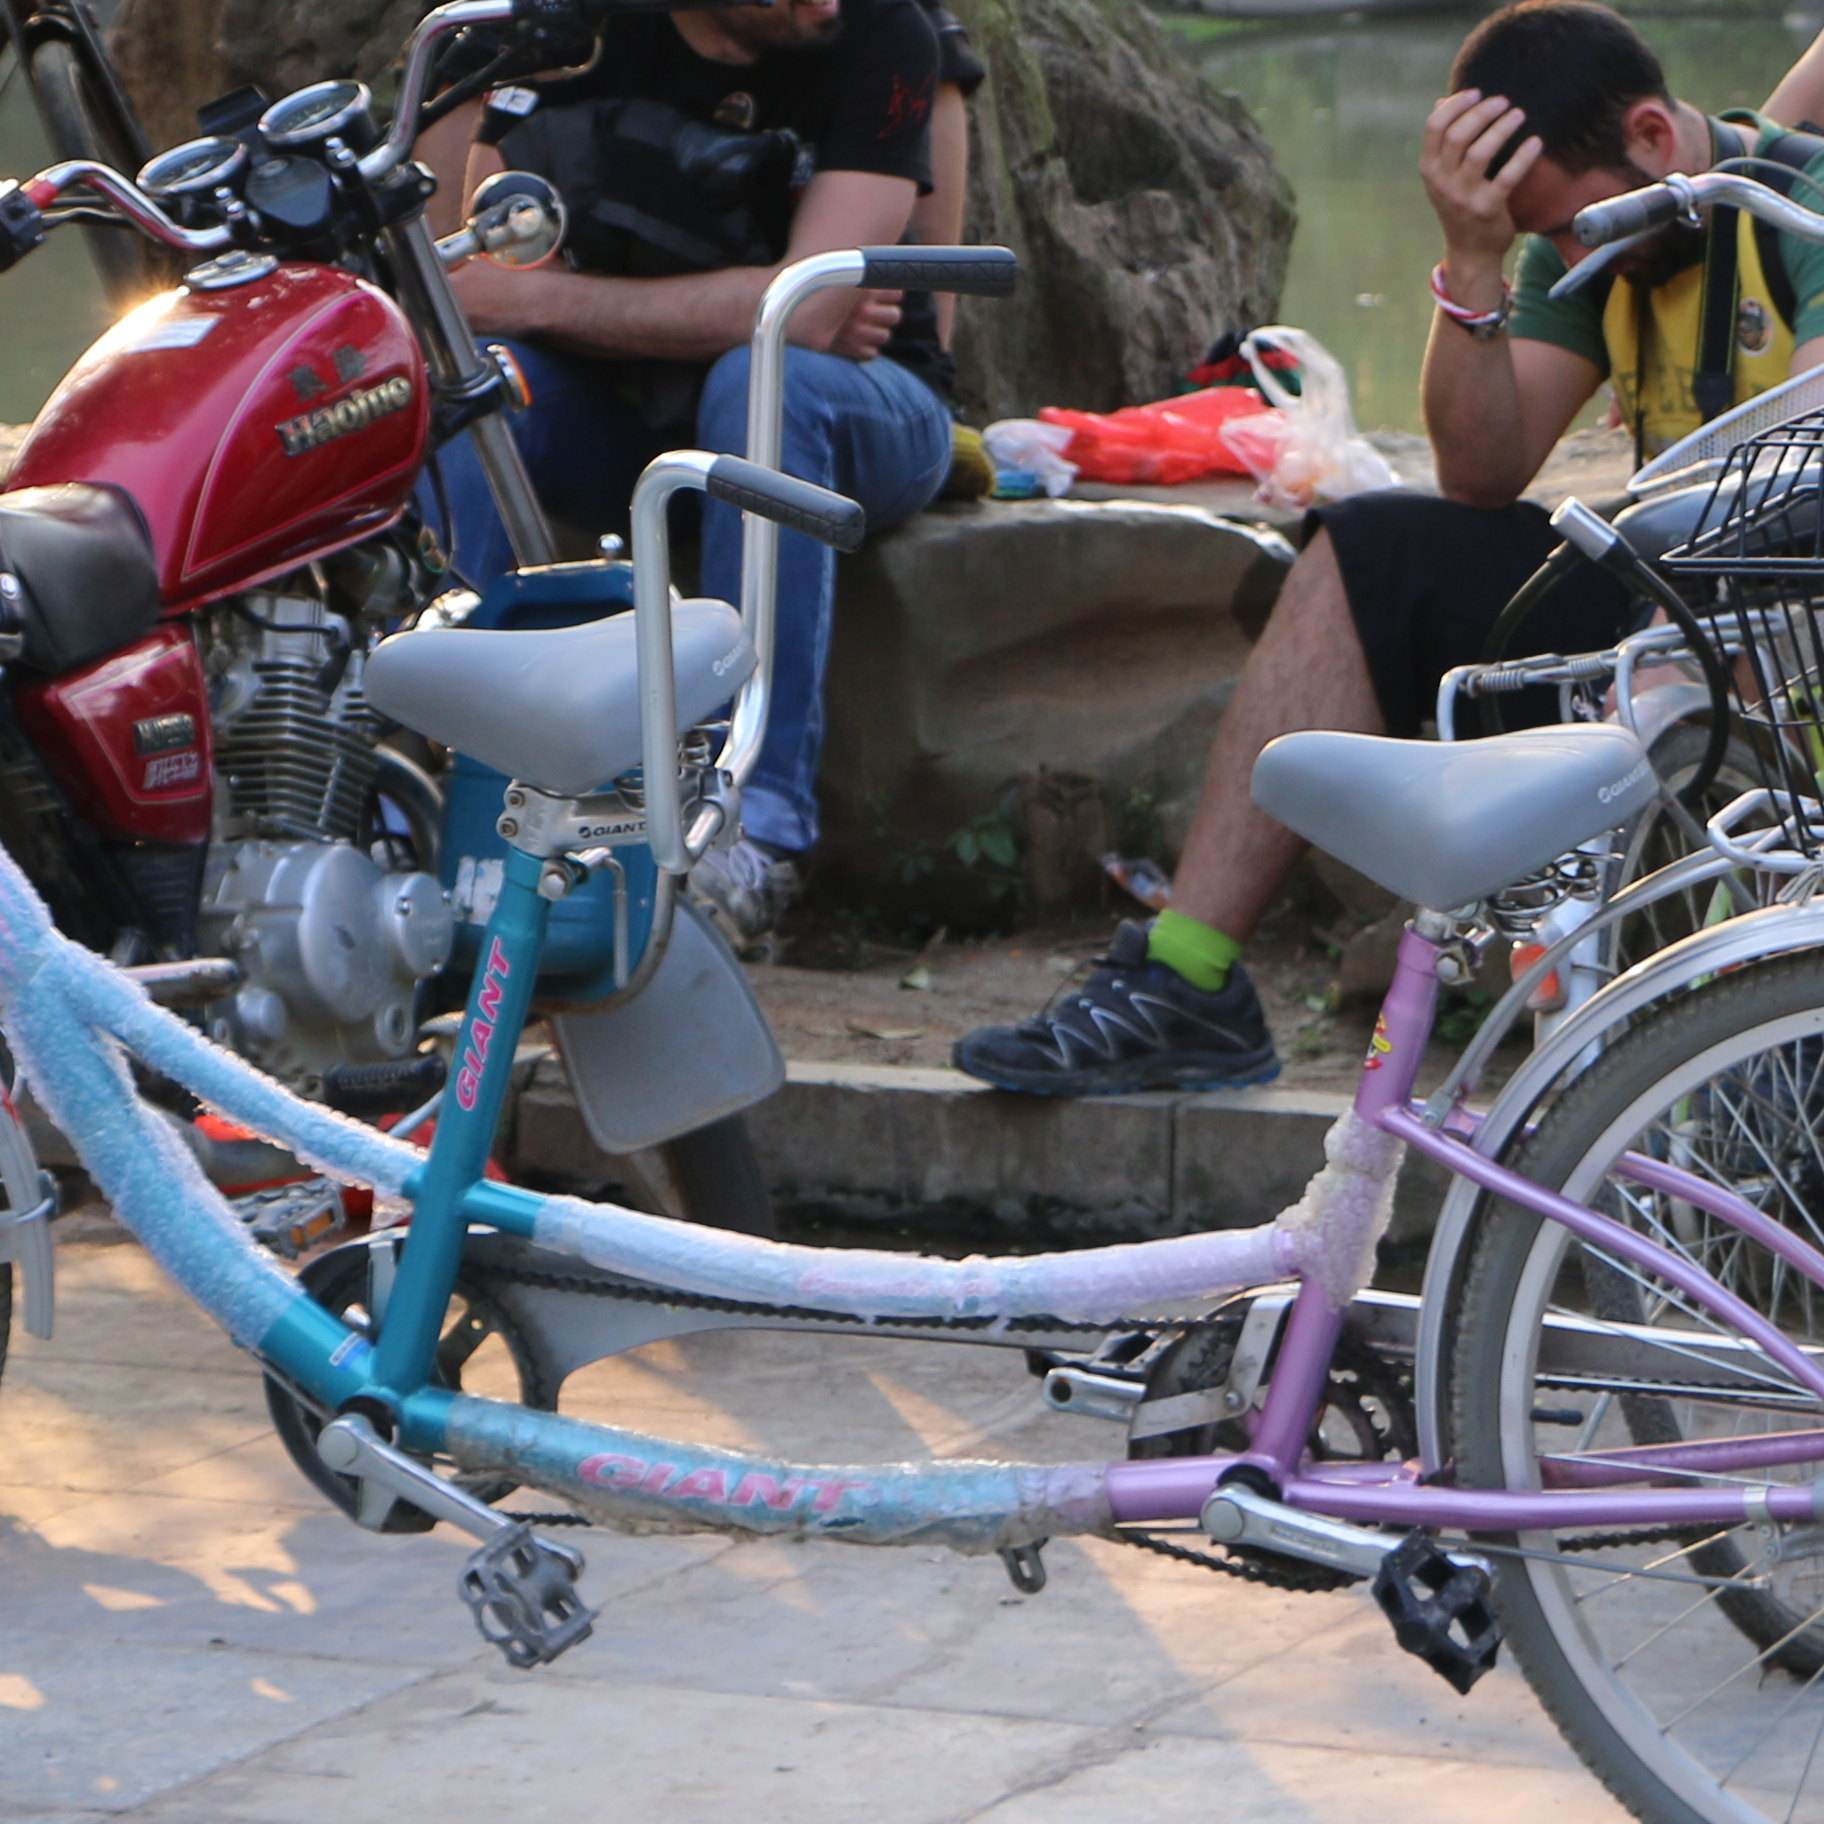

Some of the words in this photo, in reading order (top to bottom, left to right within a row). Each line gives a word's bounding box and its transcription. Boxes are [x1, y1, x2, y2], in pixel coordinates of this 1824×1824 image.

[592, 821, 647, 837] GIANT
[455, 936, 513, 1113] GIANT
[576, 1452, 868, 1514] GIANT
